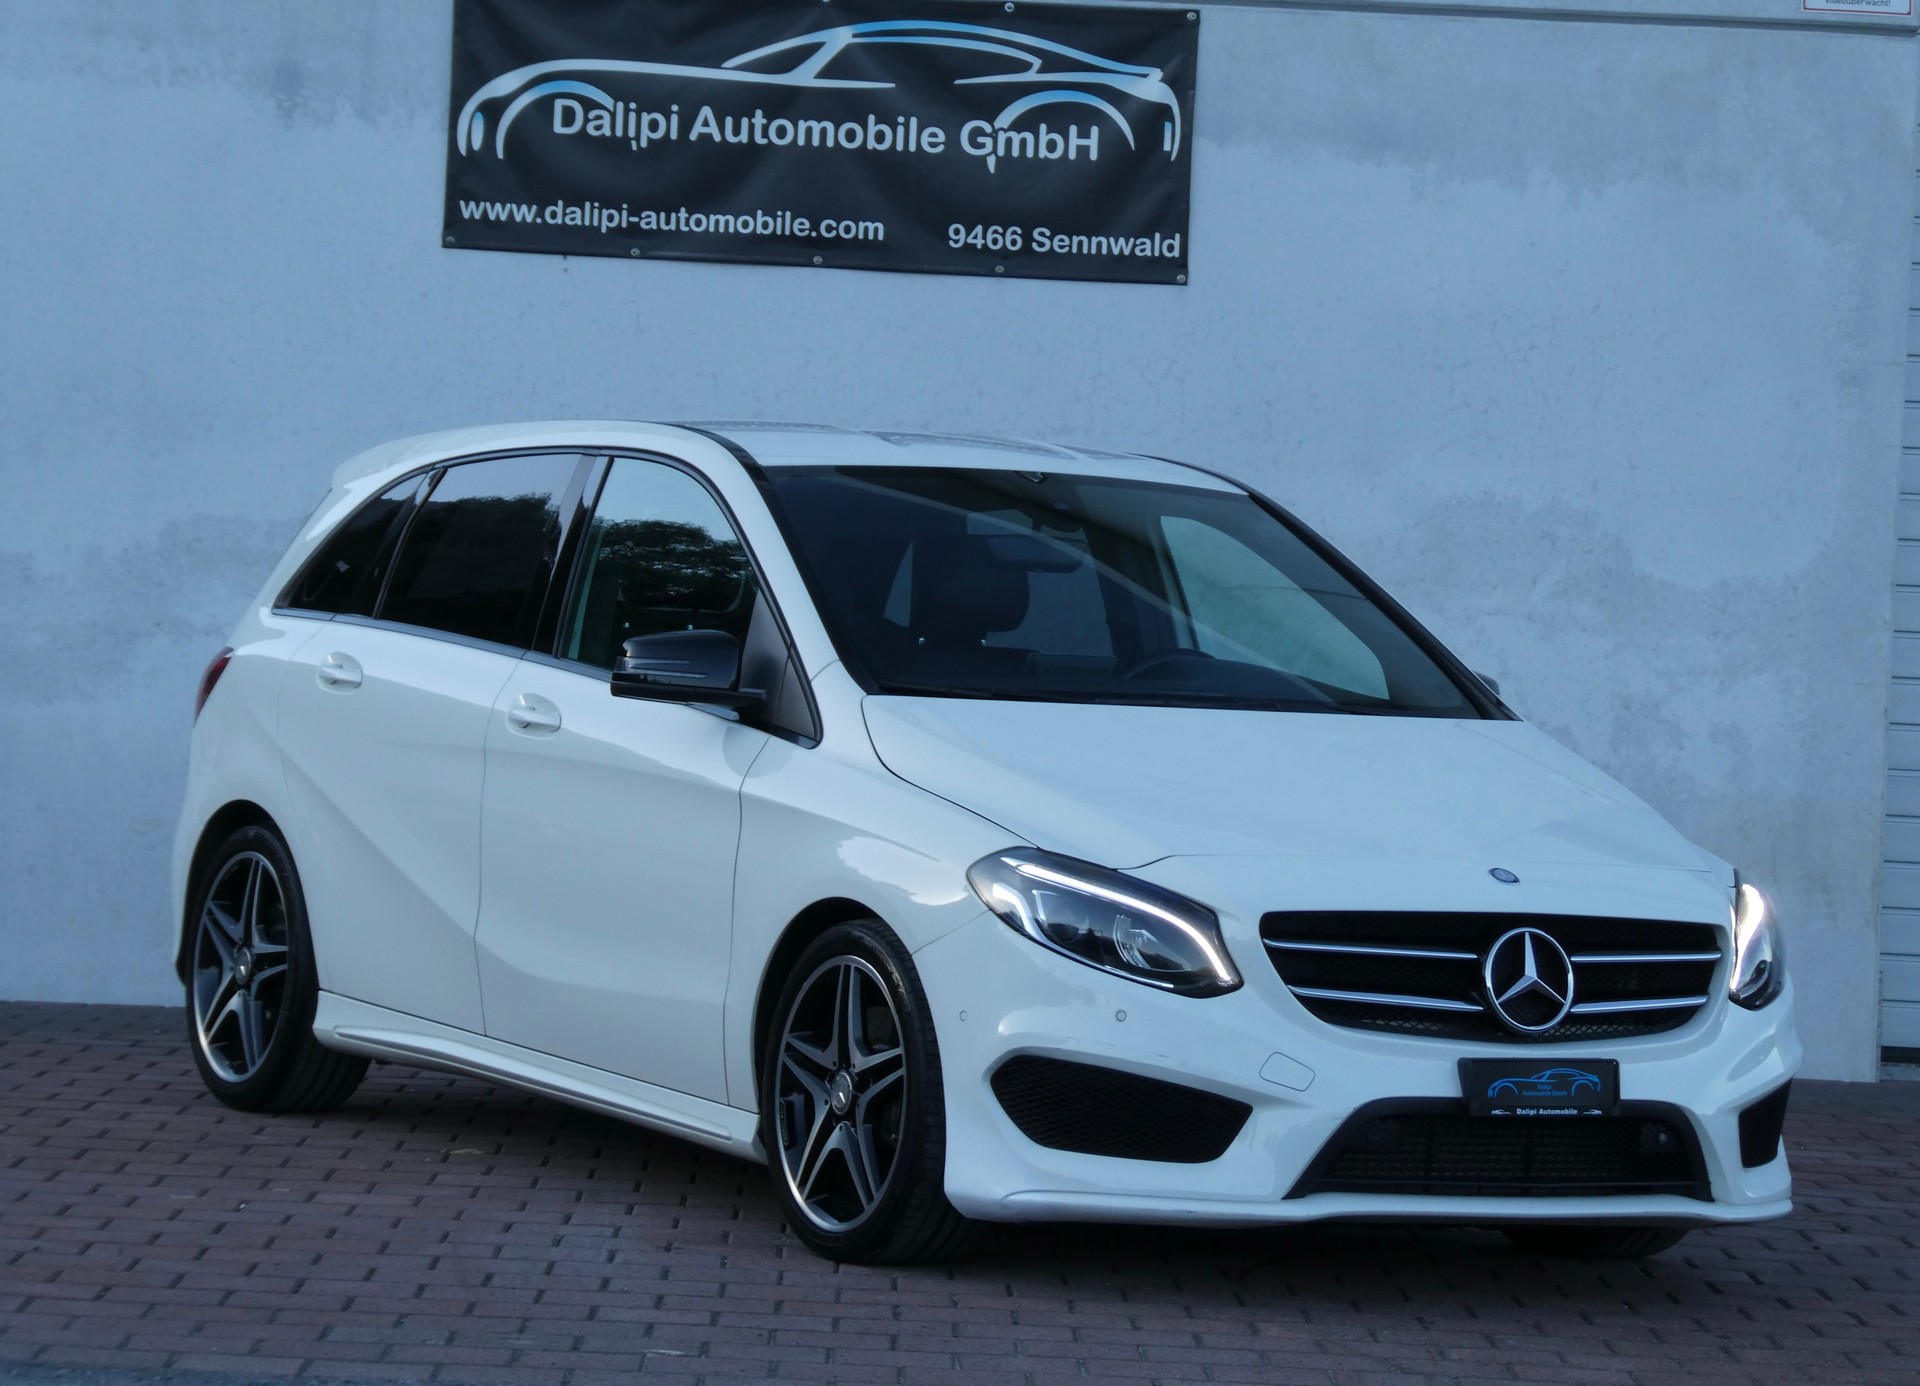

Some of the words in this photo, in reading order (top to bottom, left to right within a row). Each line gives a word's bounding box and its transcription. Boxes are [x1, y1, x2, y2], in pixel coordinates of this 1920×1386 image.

[552, 98, 680, 150] Dalipi
[686, 105, 946, 154] Automobile
[958, 119, 1100, 159] GmbH
[459, 200, 885, 242] www.dalipi-automobile.com
[948, 223, 1023, 252] 9466
[1031, 227, 1182, 258] Sennwald
